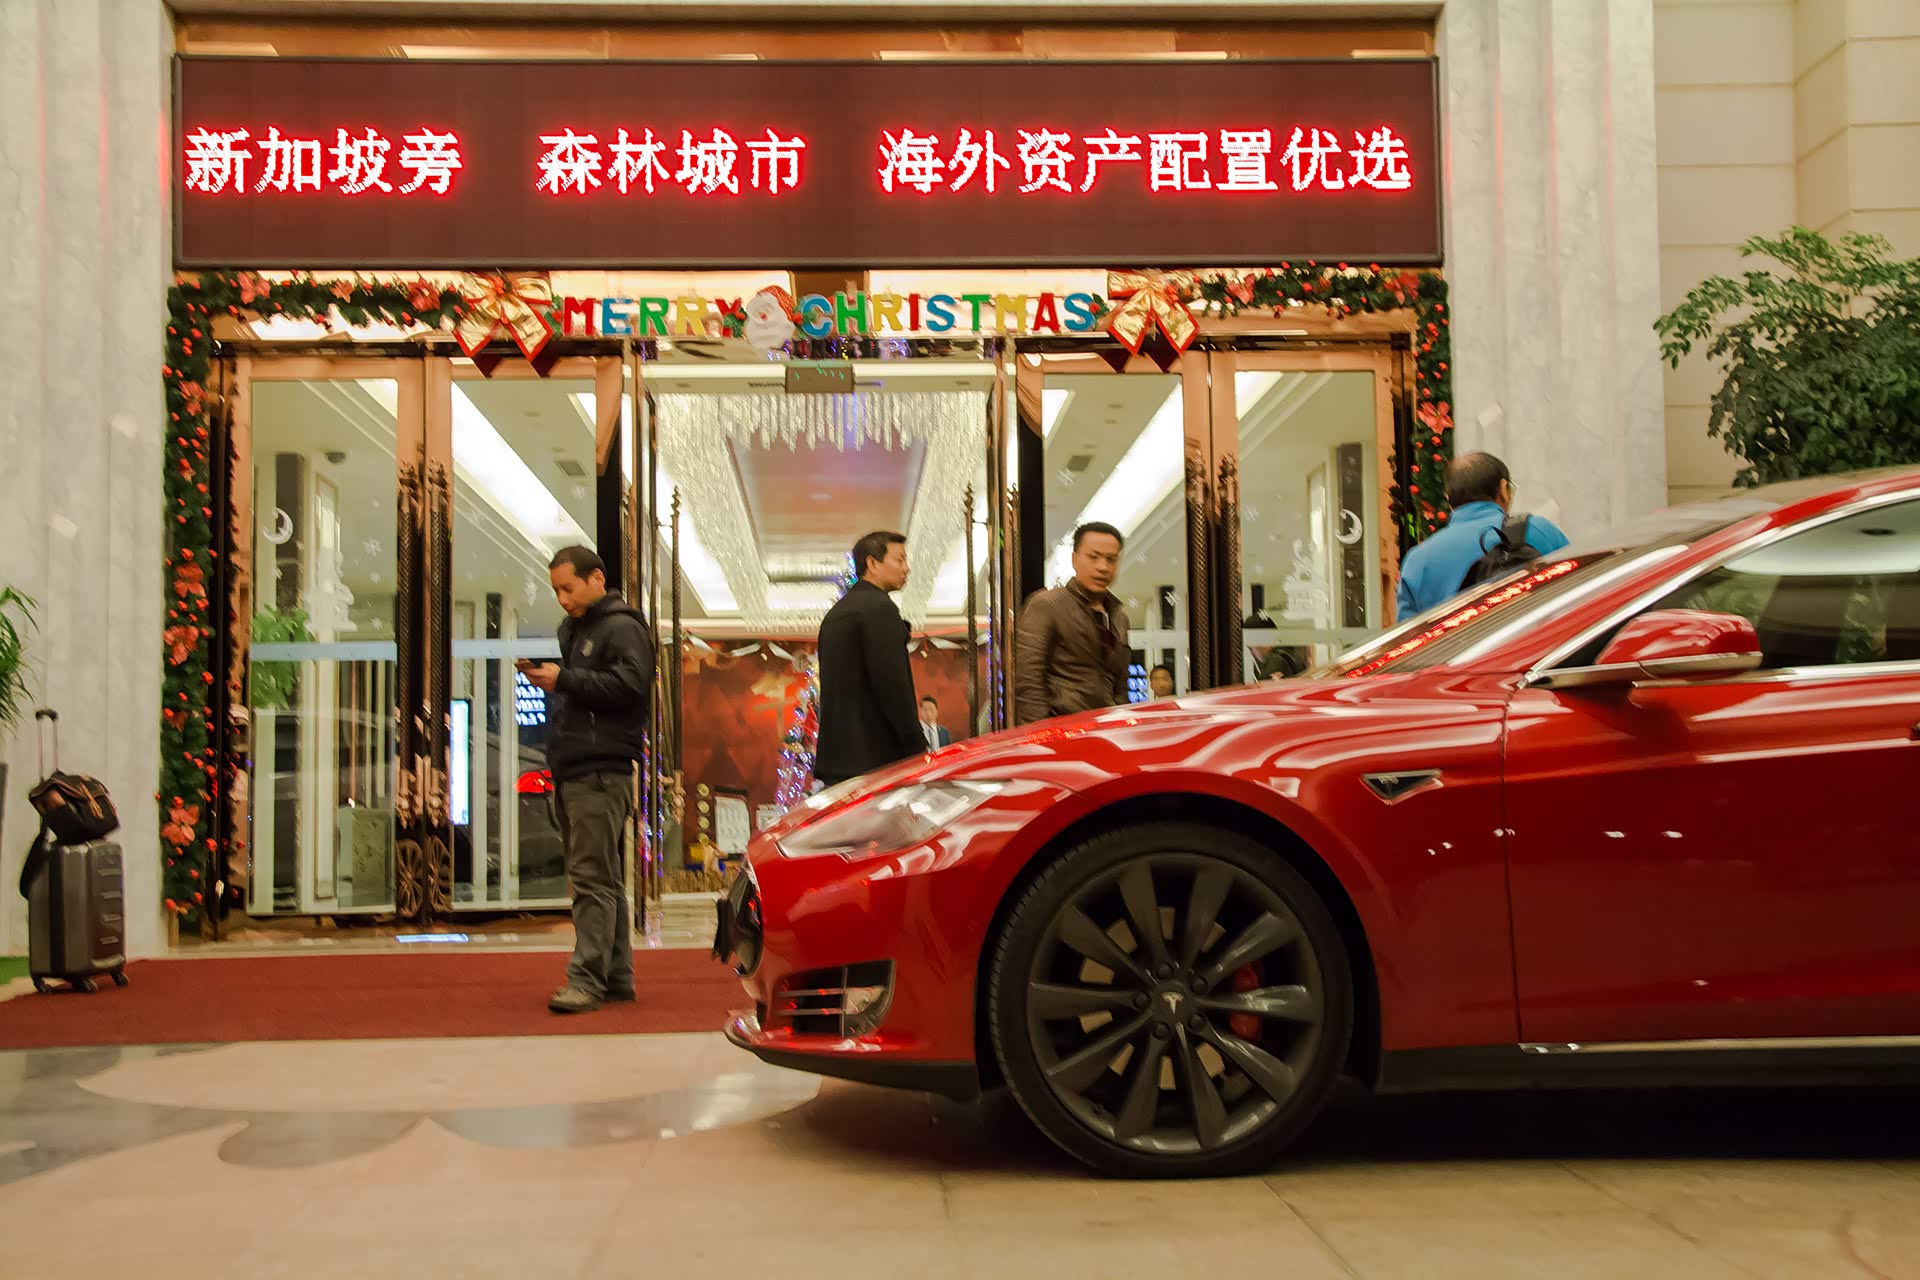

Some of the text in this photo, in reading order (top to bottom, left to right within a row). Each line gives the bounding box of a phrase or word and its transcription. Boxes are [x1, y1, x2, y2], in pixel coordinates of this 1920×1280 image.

[185, 125, 1412, 195] 新加坡旁 森林城市 海外资产配置优选
[562, 293, 1096, 338] MERRY CHRISTMAS
